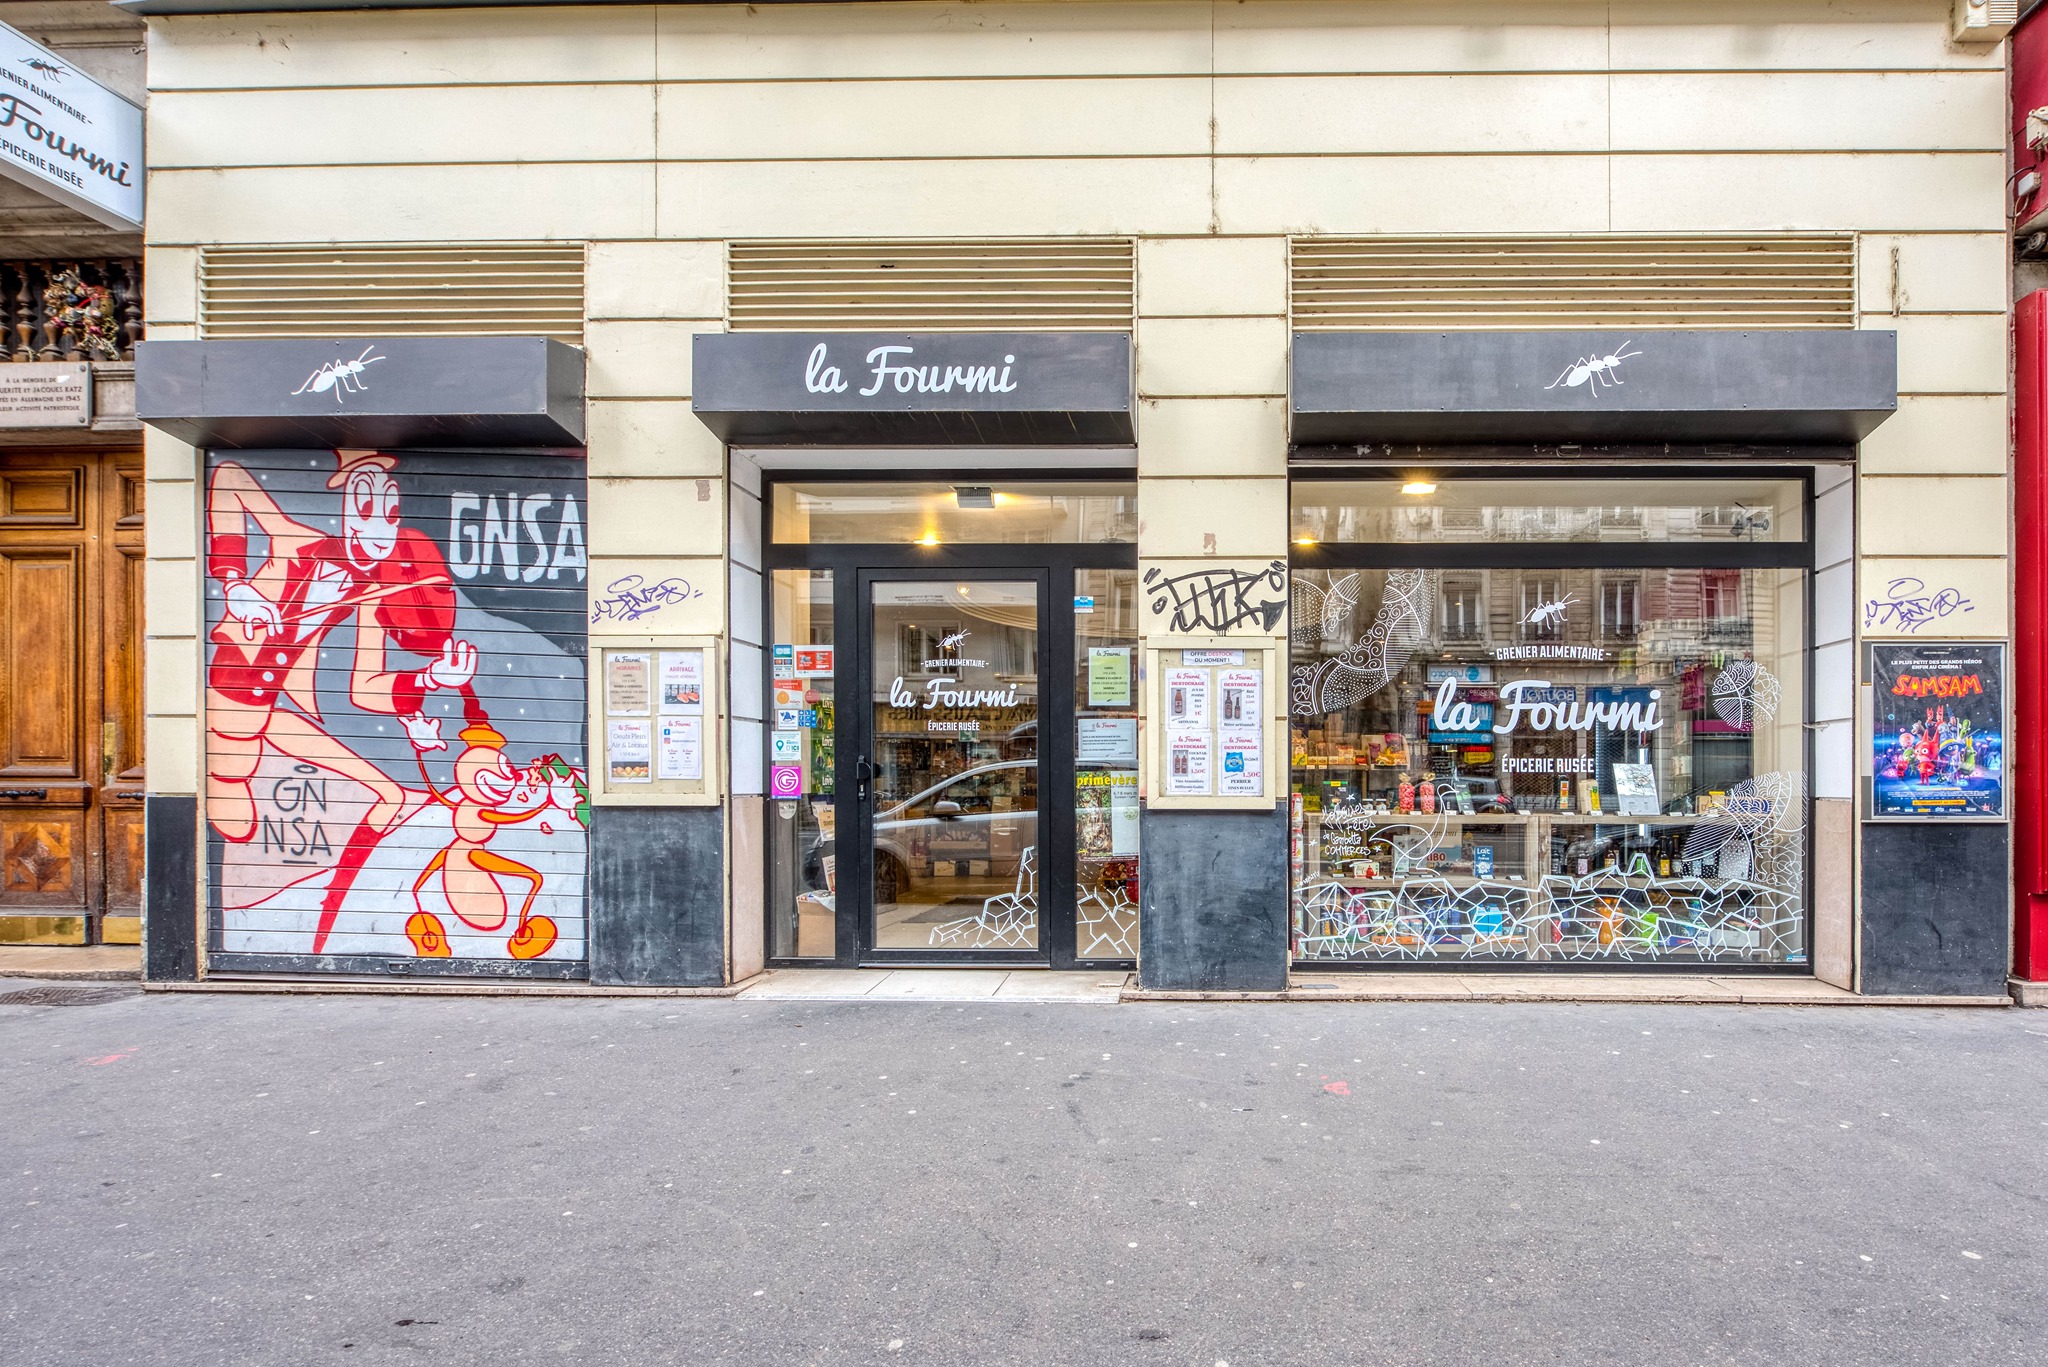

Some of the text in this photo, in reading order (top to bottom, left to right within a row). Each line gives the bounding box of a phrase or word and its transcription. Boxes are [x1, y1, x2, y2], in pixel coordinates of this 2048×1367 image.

[30, 83, 86, 123] ALIMENTAIRE
[0, 93, 132, 187] Fourmi
[48, 161, 84, 189] RUSÉE
[805, 342, 1017, 396] la Fourmi
[449, 491, 586, 583] GNSA
[924, 658, 985, 668] GRENIER ALIMENTAIRE
[1103, 649, 1121, 657] Fourmi
[1496, 644, 1604, 661] GRENIER ALIMENTAIRE
[1183, 672, 1200, 680] Fourmi
[1891, 674, 1983, 698] SAMSAM
[889, 676, 1019, 710] la Fourmi
[1433, 676, 1664, 735] la Fourmi
[927, 719, 980, 731] ÉPICERIE RUSÉE
[1184, 735, 1202, 743] Fourmi
[1501, 753, 1595, 773] ÉPICERIE RUSÉE
[1076, 773, 1138, 789] primevère
[272, 776, 327, 813] GN
[262, 815, 333, 858] NSA
[1324, 844, 1371, 856] COMMERCES
[1476, 847, 1491, 855] Lait
